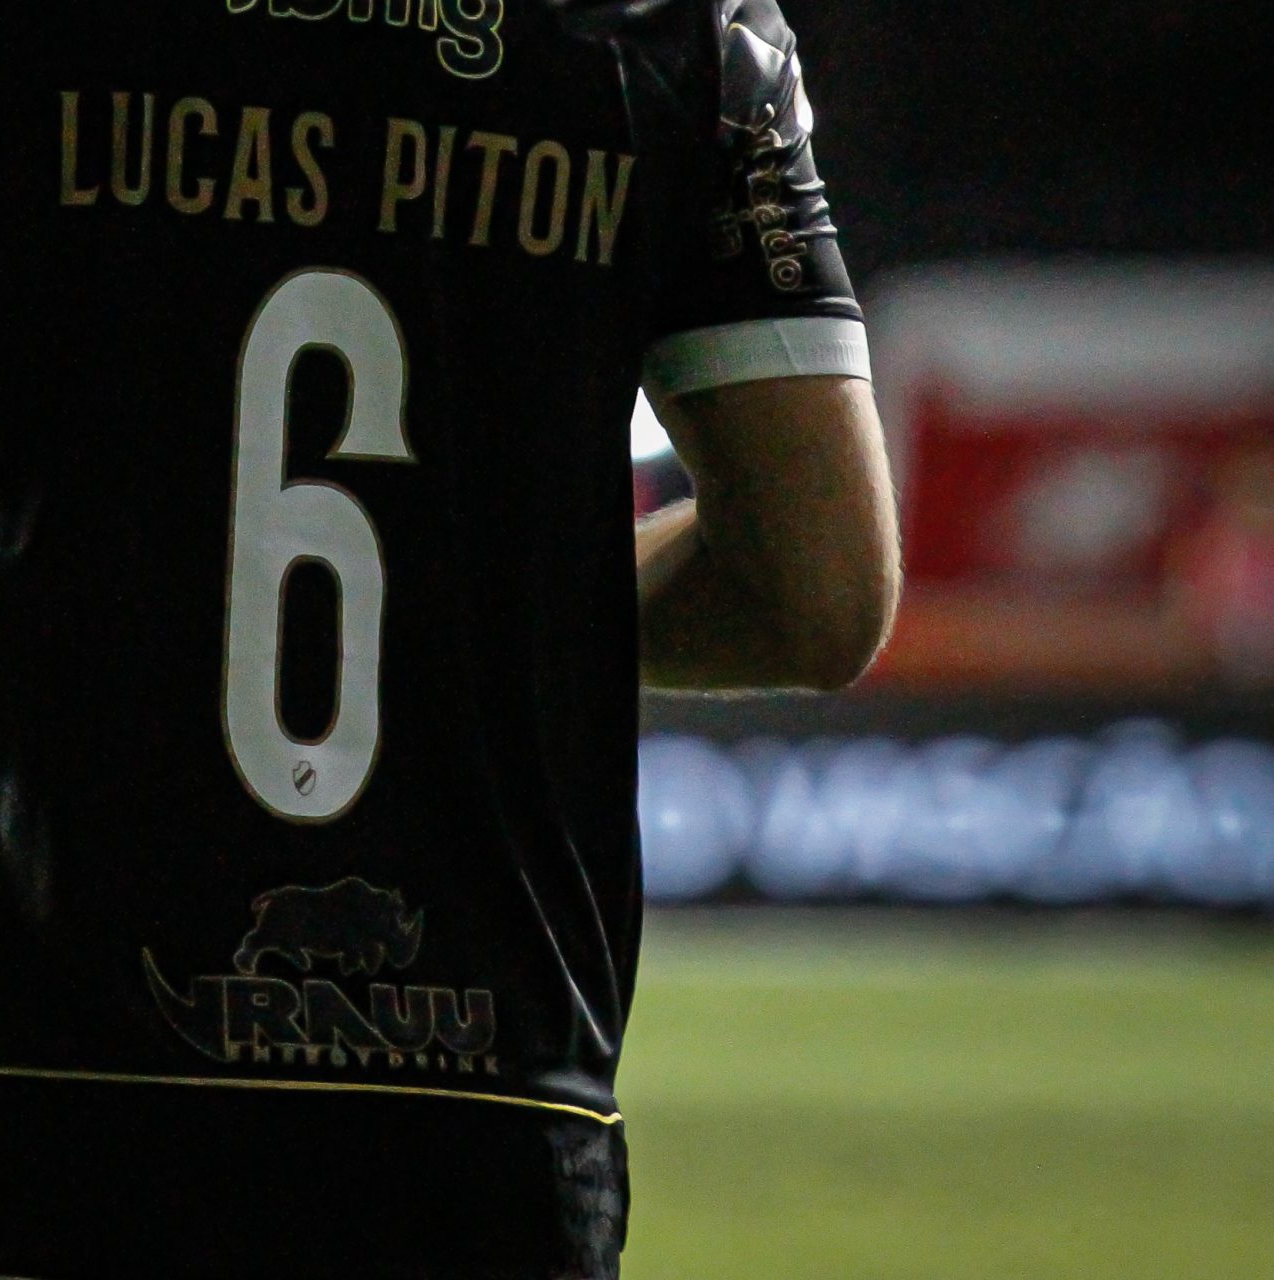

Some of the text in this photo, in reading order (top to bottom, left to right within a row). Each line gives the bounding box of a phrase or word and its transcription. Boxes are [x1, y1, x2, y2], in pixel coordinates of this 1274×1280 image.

[58, 89, 638, 267] LUCAS PITON
[221, 265, 421, 824] 6
